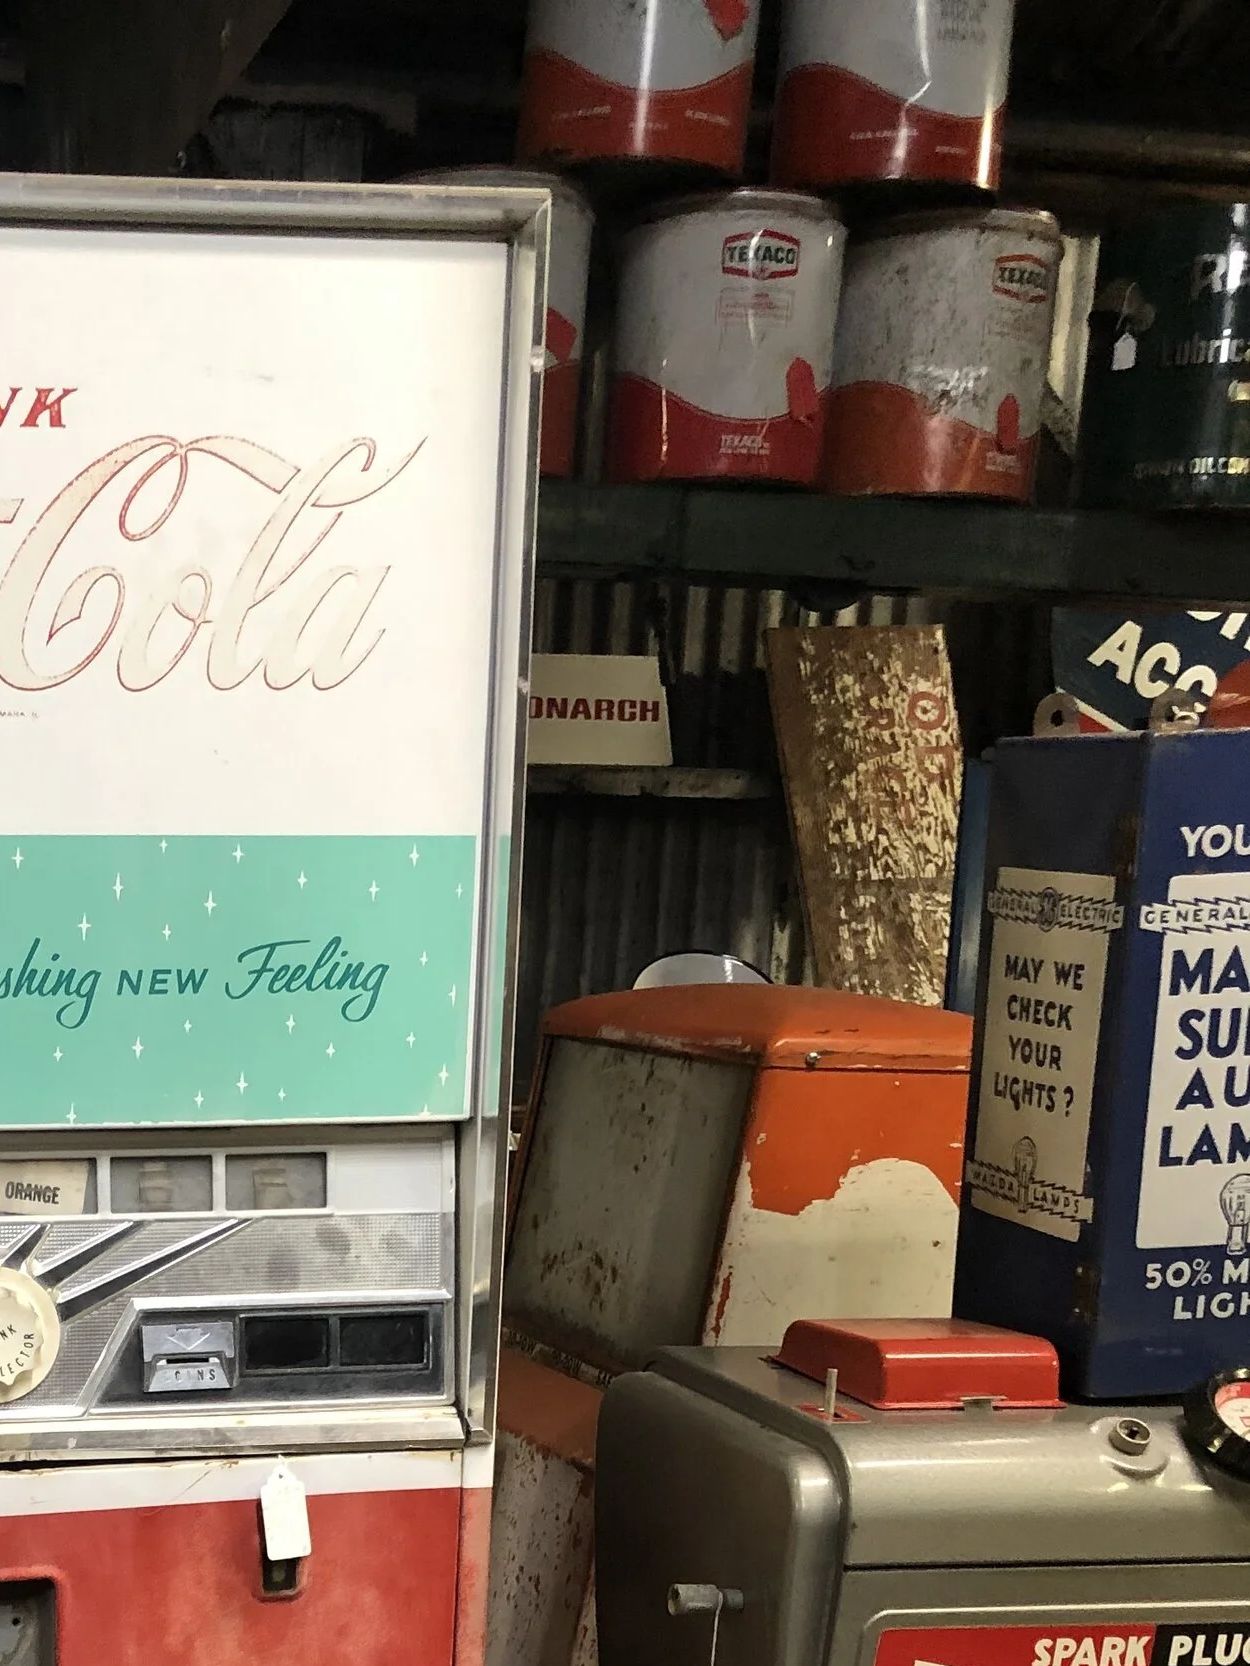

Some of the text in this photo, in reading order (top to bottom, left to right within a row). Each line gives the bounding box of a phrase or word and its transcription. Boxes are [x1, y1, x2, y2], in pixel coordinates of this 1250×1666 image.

[529, 696, 660, 722] ONARCH
[1060, 903, 1120, 924] ELECTRIC
[1144, 906, 1249, 925] GENERAL
[116, 968, 209, 997] NEW
[224, 935, 390, 1023] Feeling
[1004, 954, 1085, 991] MAY WE
[1007, 994, 1073, 1031] CHECK
[1175, 1007, 1250, 1060] SU
[1008, 1034, 1062, 1071] YOUR
[4, 1181, 61, 1204] ORANGE
[1145, 1258, 1213, 1290] 50%
[1168, 1633, 1250, 1666] PLU
